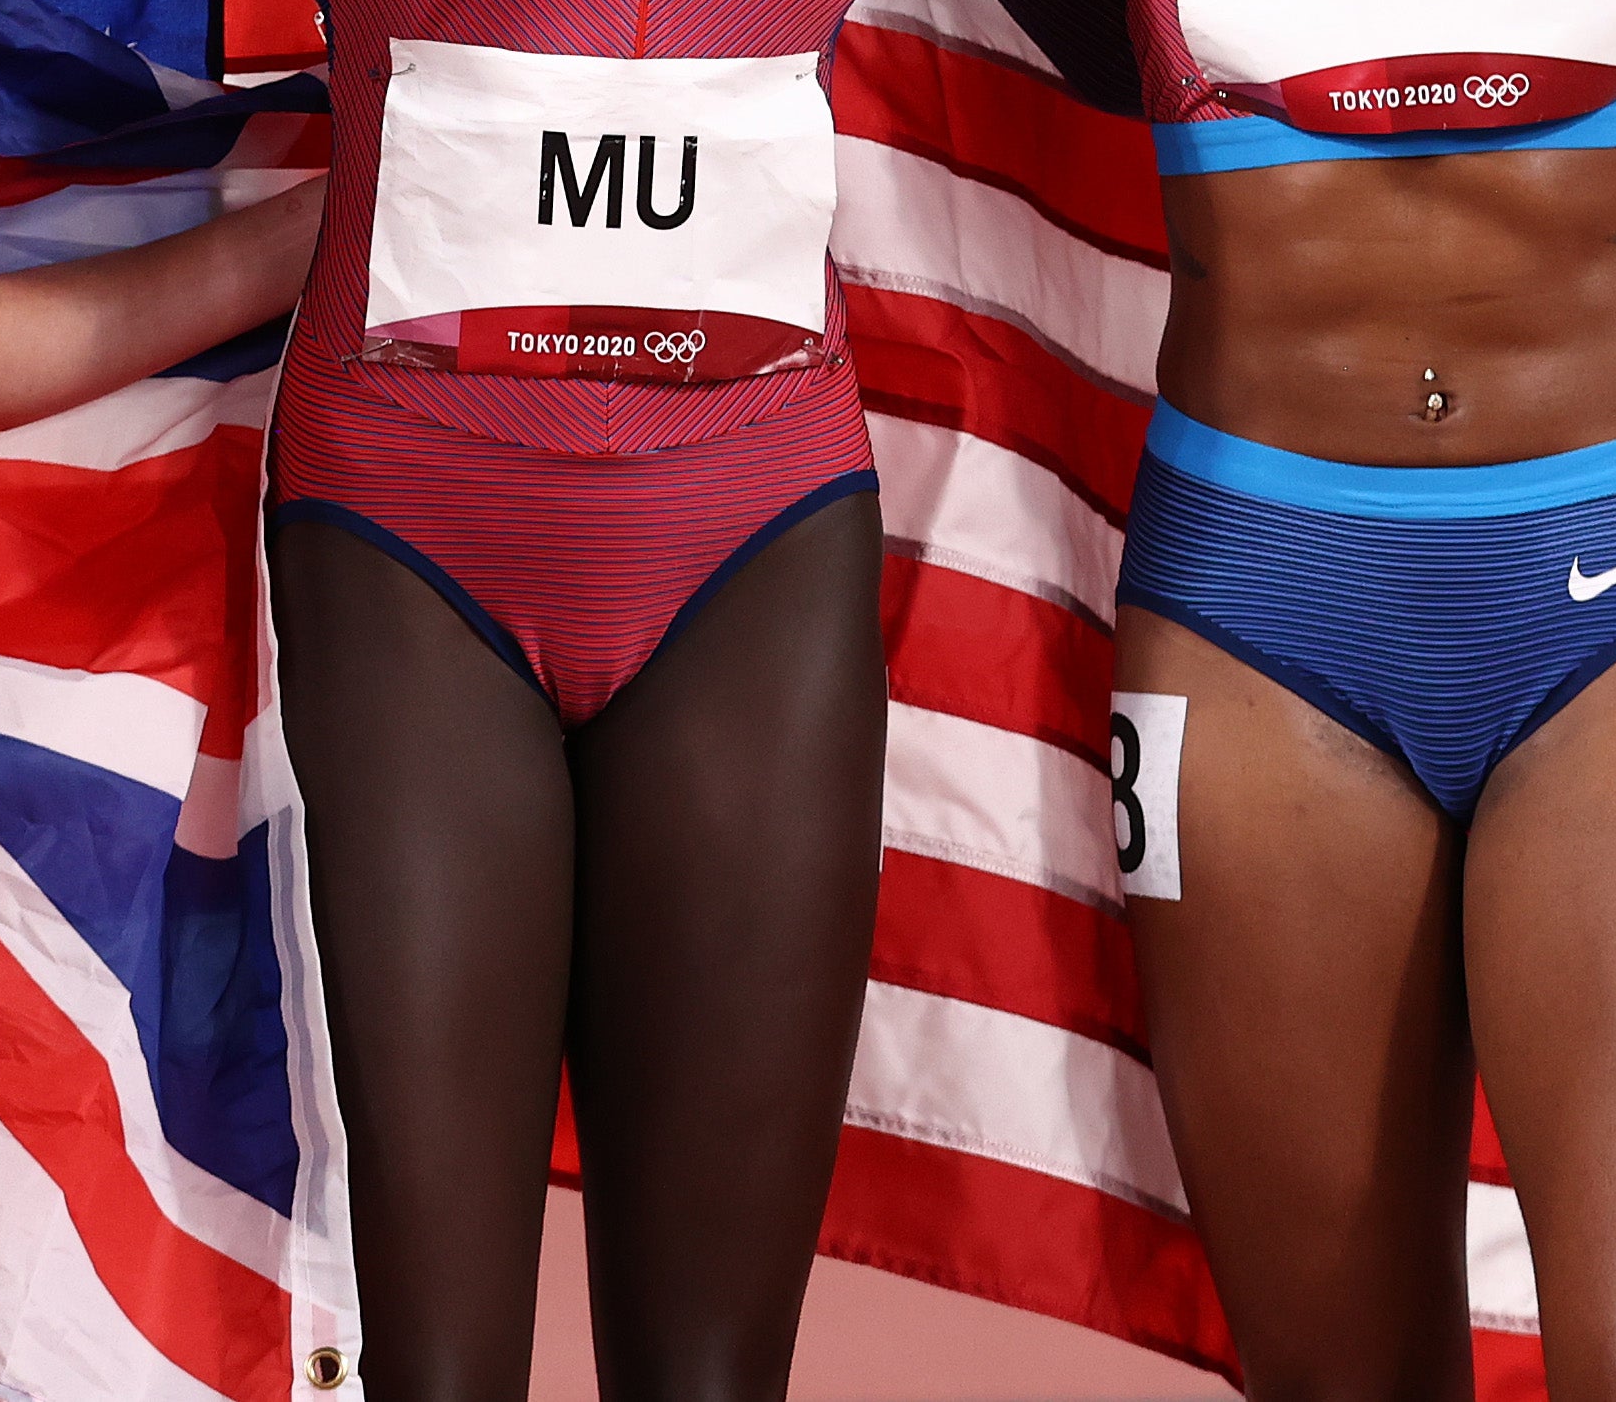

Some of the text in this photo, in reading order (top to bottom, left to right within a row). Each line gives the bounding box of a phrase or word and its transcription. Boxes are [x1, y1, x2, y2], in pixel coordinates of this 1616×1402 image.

[1329, 84, 1456, 110] TOKYO 2020
[538, 131, 698, 230] MU
[507, 330, 636, 356] TOKYO 2020
